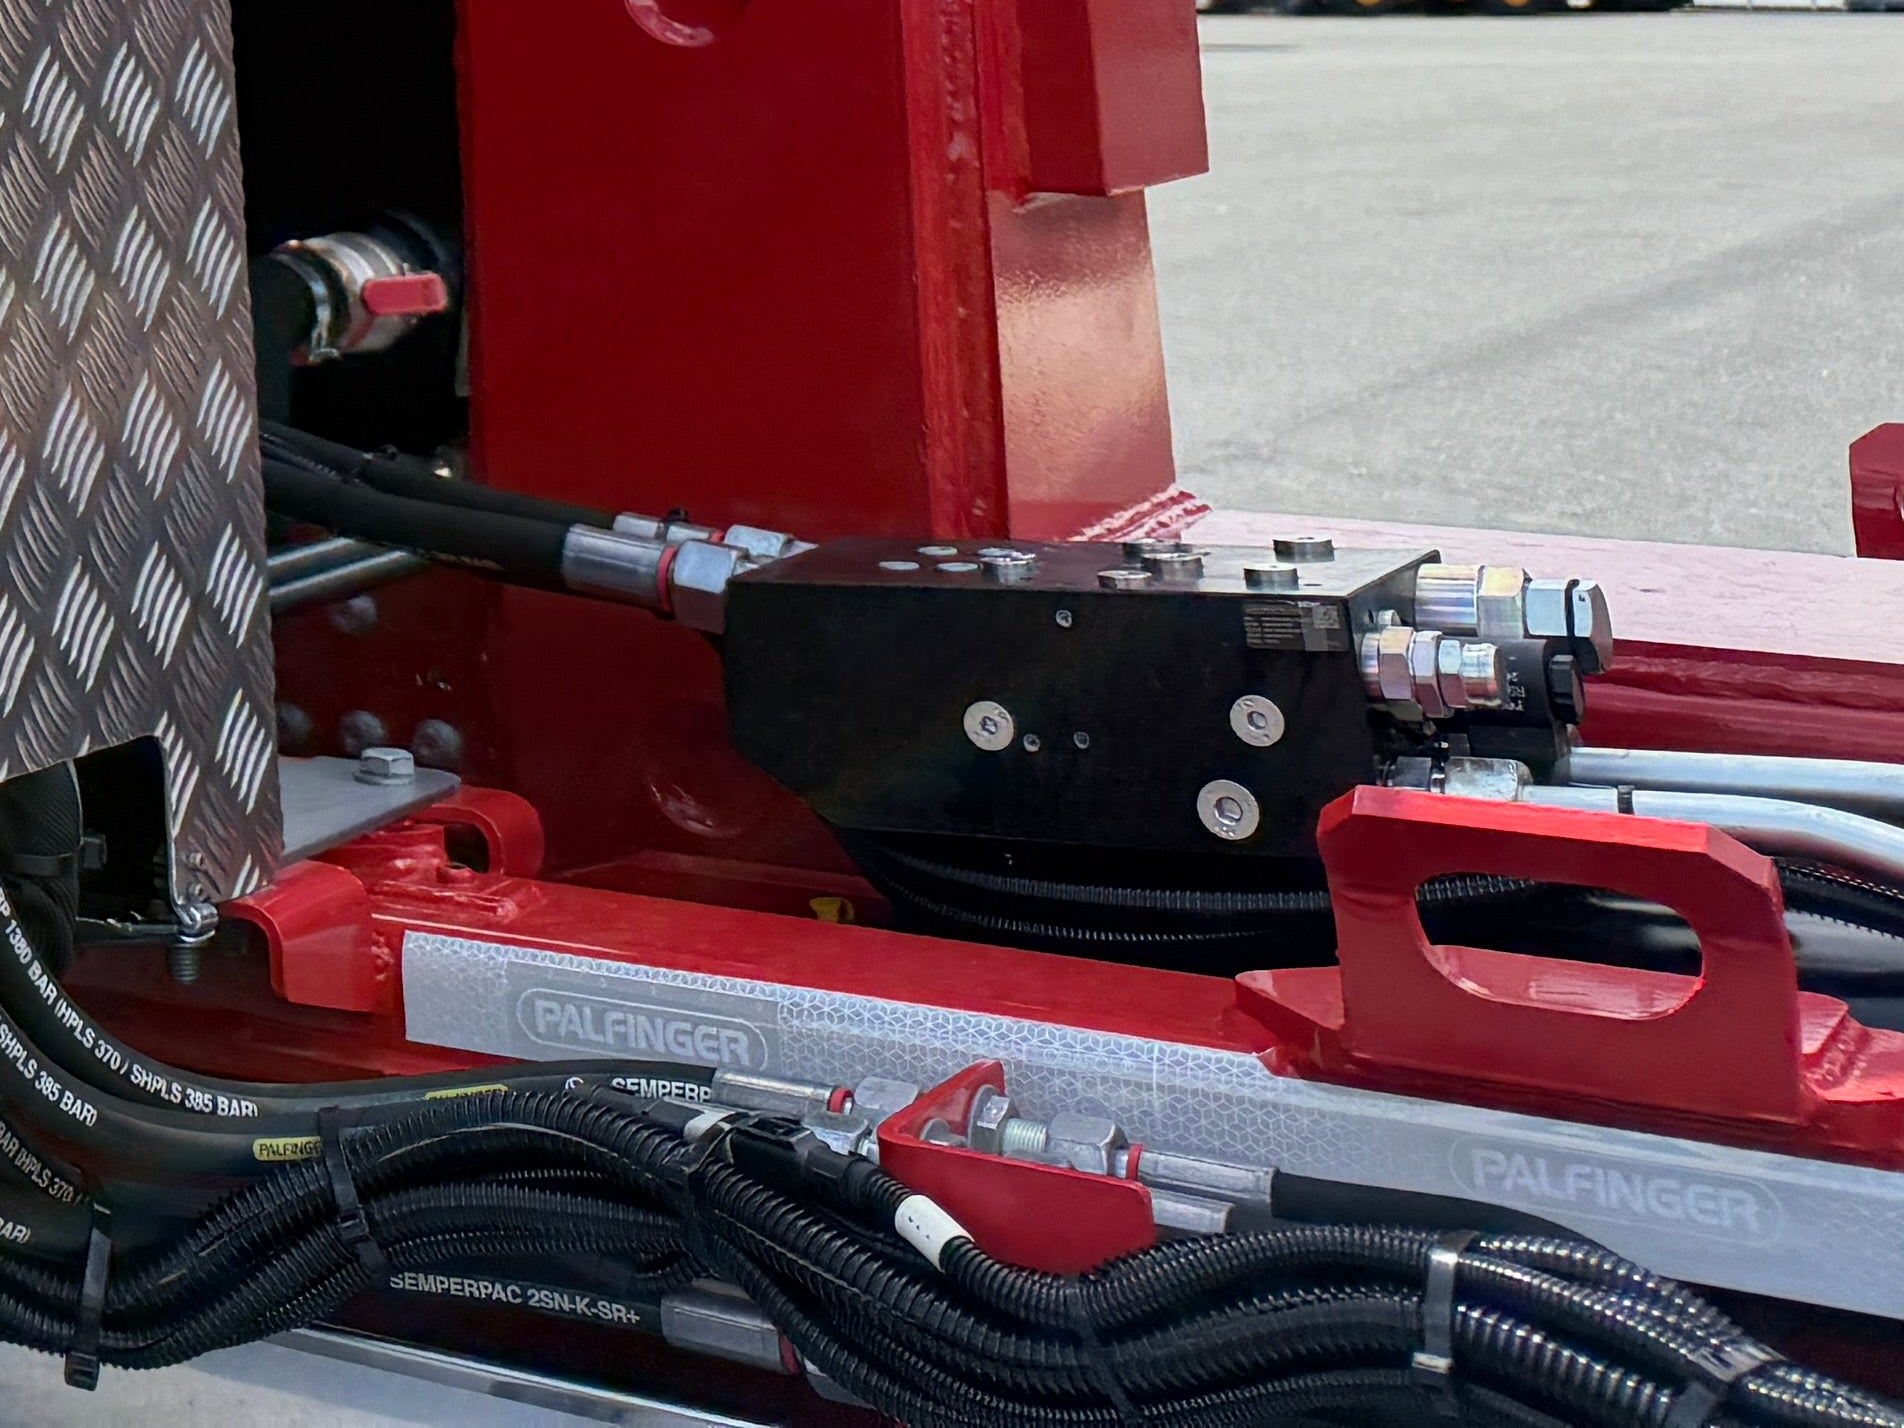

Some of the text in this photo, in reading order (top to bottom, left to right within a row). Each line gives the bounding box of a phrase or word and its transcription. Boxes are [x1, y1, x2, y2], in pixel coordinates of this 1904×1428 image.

[4, 920, 32, 965] 1380
[26, 961, 59, 1006] BAR
[55, 999, 96, 1049] (HPLS
[94, 1040, 122, 1071] 370
[130, 1063, 183, 1104] SHPLS
[184, 1088, 213, 1113] 385
[216, 1095, 259, 1118] BAR)
[535, 998, 750, 1069] PALFINGER
[33, 1071, 61, 1103] 385
[58, 1083, 98, 1128] BAR)
[49, 1177, 75, 1203] 370
[1471, 1148, 1760, 1232] PALFINGER
[389, 1272, 641, 1325] SEMPERPAC 2SN-K-SR+
